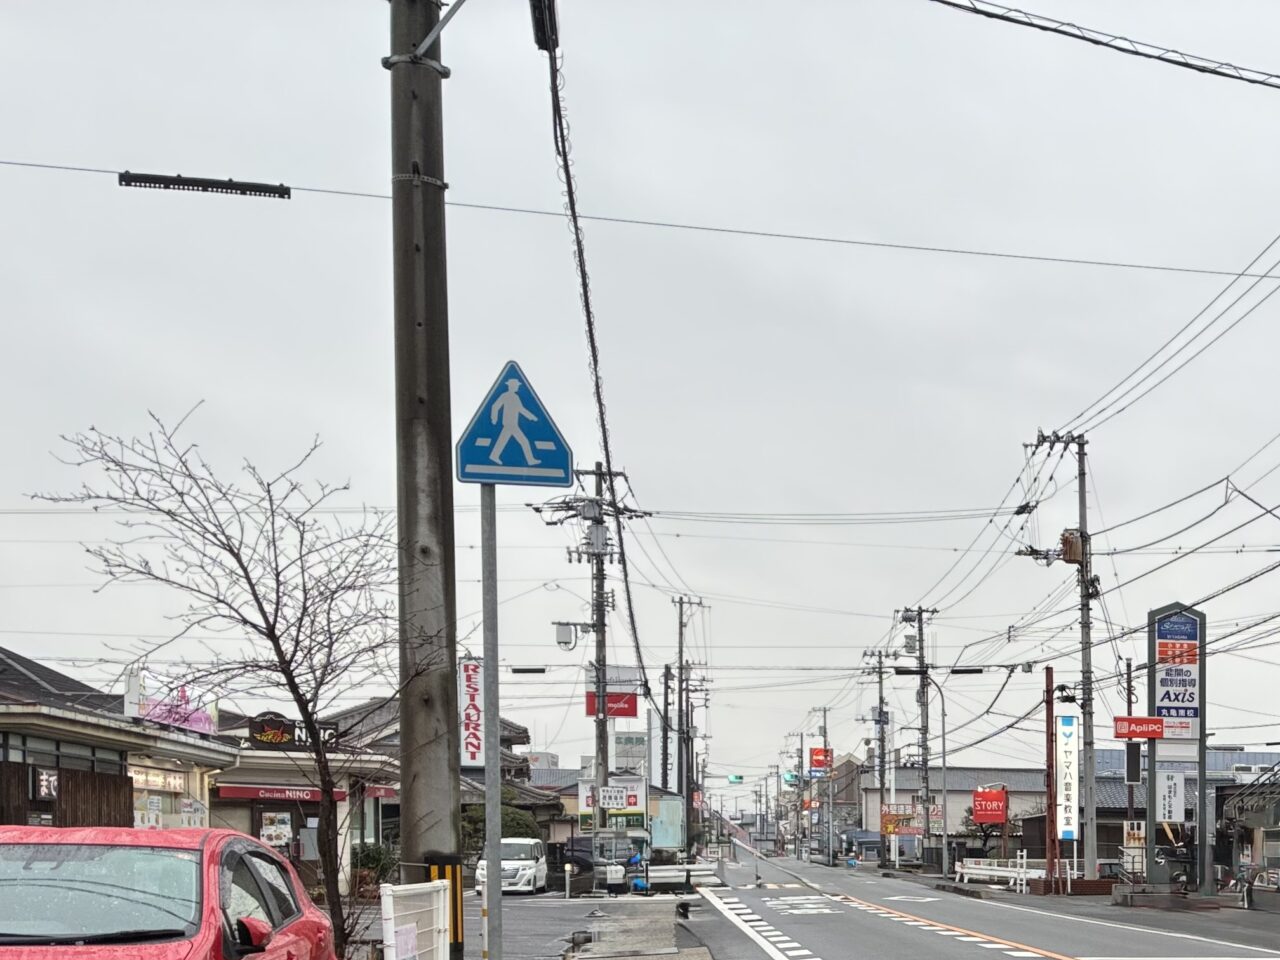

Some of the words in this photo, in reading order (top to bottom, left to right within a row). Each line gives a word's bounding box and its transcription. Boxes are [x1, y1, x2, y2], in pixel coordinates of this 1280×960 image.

[463, 664, 481, 761] RESTAURANT
[285, 790, 311, 799] NINO
[975, 801, 1004, 810] STORY
[1064, 750, 1073, 826] ヤマハ音楽教室
